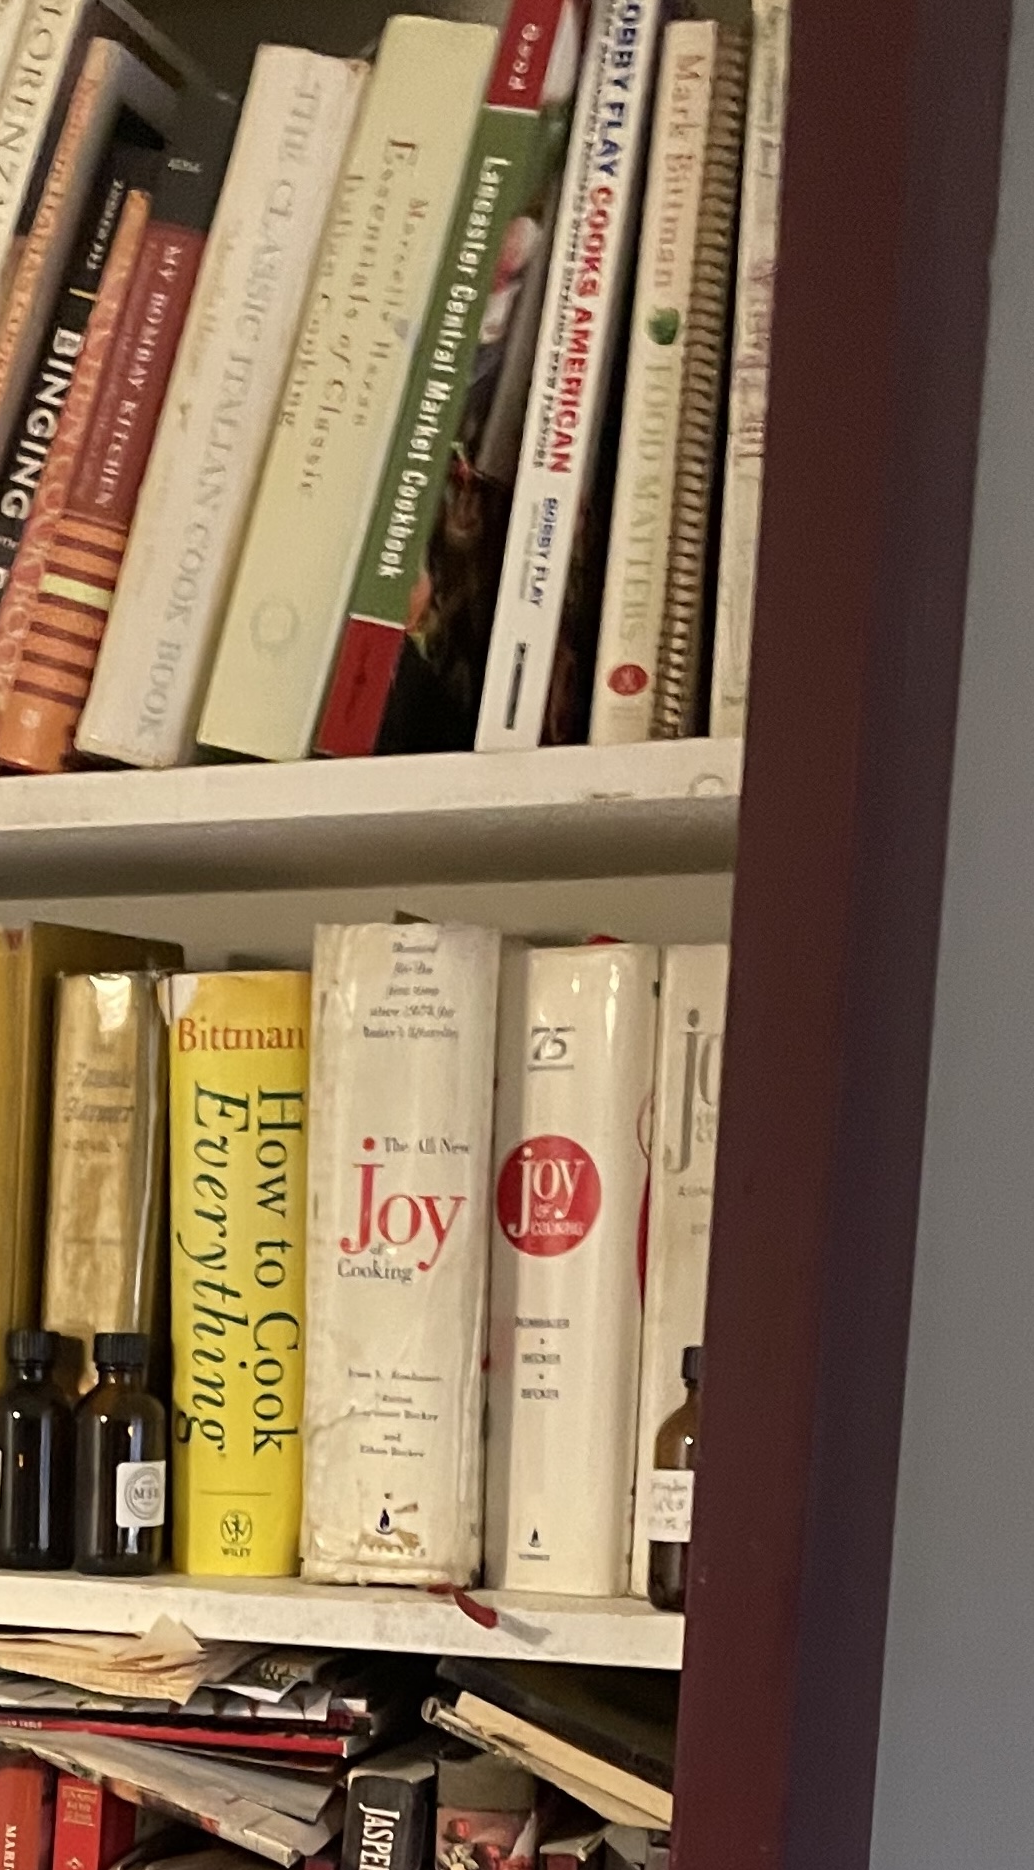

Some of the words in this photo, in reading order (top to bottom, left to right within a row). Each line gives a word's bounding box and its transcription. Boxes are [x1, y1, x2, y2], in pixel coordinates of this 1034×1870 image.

[611, 0, 642, 90] OBBY
[596, 102, 625, 177] FLAY
[669, 54, 705, 136] Mark
[160, 245, 182, 281] MY
[235, 179, 296, 342] CLASSIC
[457, 156, 512, 279] Lancaster
[575, 186, 614, 297] COOKS
[655, 153, 695, 288] Bittman
[430, 283, 478, 373] Central
[1, 326, 86, 520] BINGING
[197, 354, 254, 510] ITALIAN
[407, 379, 455, 462] Market
[547, 305, 593, 473] AMERICAN
[638, 364, 672, 461] FOOD
[166, 521, 209, 624] COOK
[377, 469, 429, 580] Cookbook
[536, 498, 558, 560] BOBBY
[620, 474, 660, 642] MATTERS
[529, 565, 550, 607] FLAY
[139, 638, 182, 737] BOOK
[178, 1017, 306, 1052] Bittman
[531, 1026, 575, 1060] 75
[254, 1084, 306, 1219] How
[384, 1137, 408, 1152] The
[441, 1138, 470, 1154] New
[174, 1080, 251, 1458] Everything
[254, 1238, 294, 1289] to
[337, 1258, 414, 1284] Cooking
[253, 1311, 300, 1457] Cook
